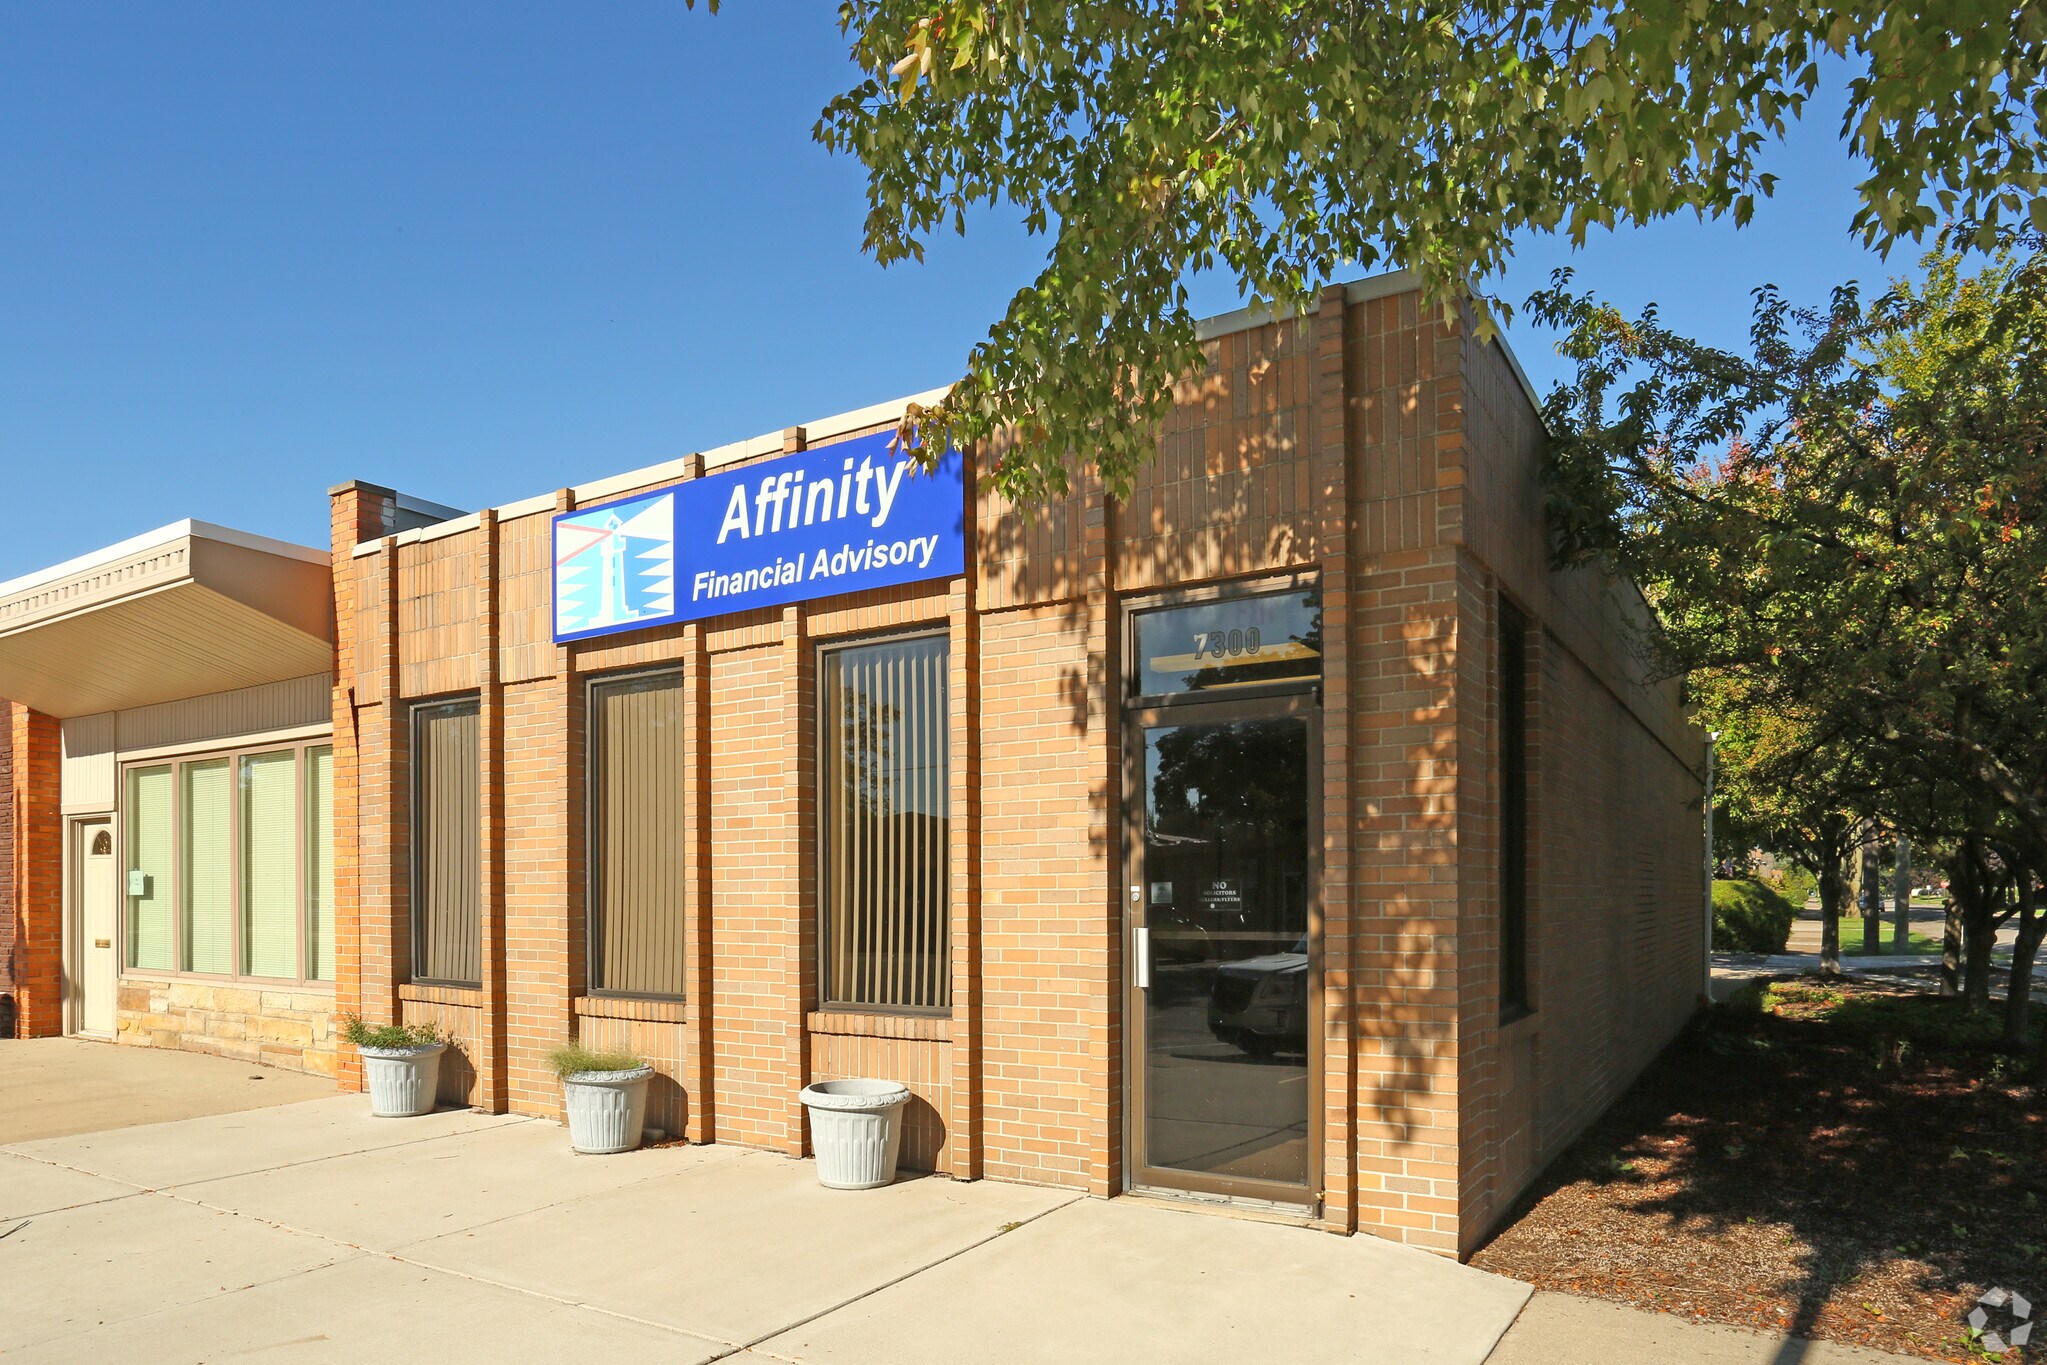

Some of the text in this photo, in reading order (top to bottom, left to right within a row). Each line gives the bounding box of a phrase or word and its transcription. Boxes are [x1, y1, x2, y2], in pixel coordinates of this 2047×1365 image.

[717, 455, 907, 544] Affinity
[692, 535, 939, 601] Financial Advisory
[1193, 627, 1261, 660] 7300
[1212, 881, 1227, 890] NO
